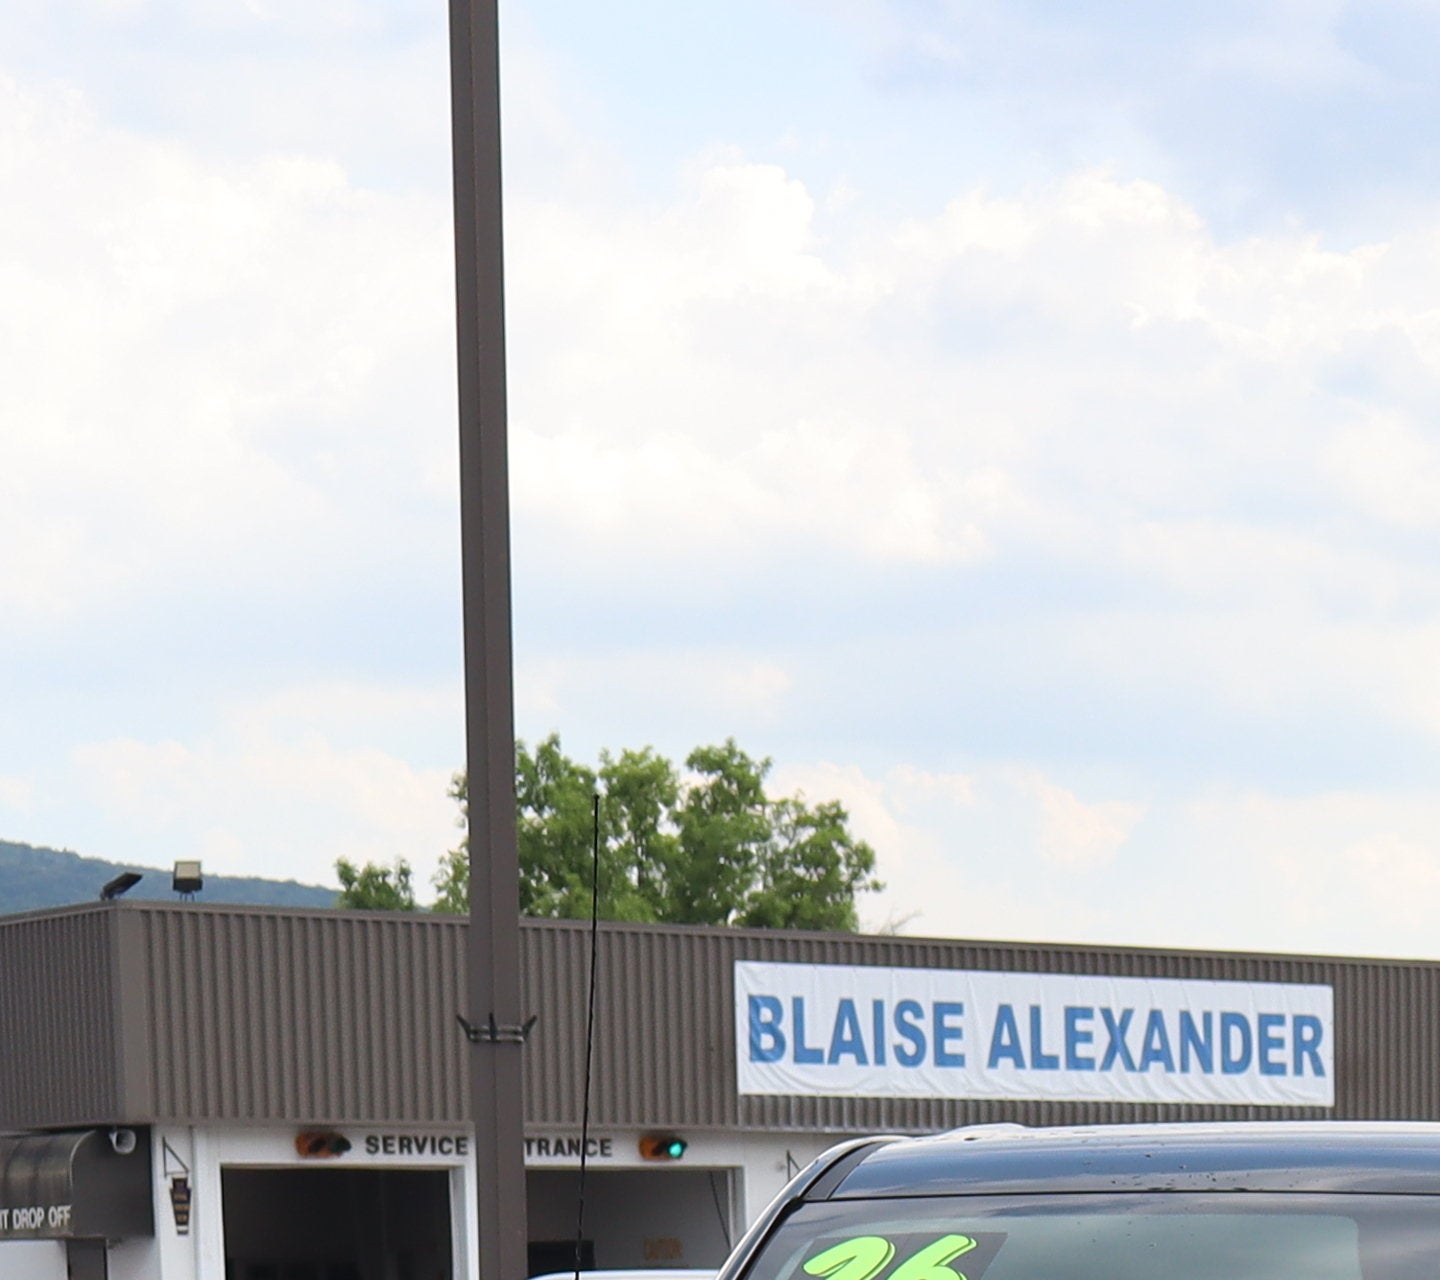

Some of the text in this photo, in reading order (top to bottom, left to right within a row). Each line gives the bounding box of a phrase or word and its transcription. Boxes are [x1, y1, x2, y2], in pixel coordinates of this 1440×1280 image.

[746, 993, 1328, 1077] BLAISE ALEXANDER
[364, 1135, 613, 1158] SERVICE TRANCE
[12, 1206, 45, 1230] DROP
[48, 1204, 72, 1228] OFF
